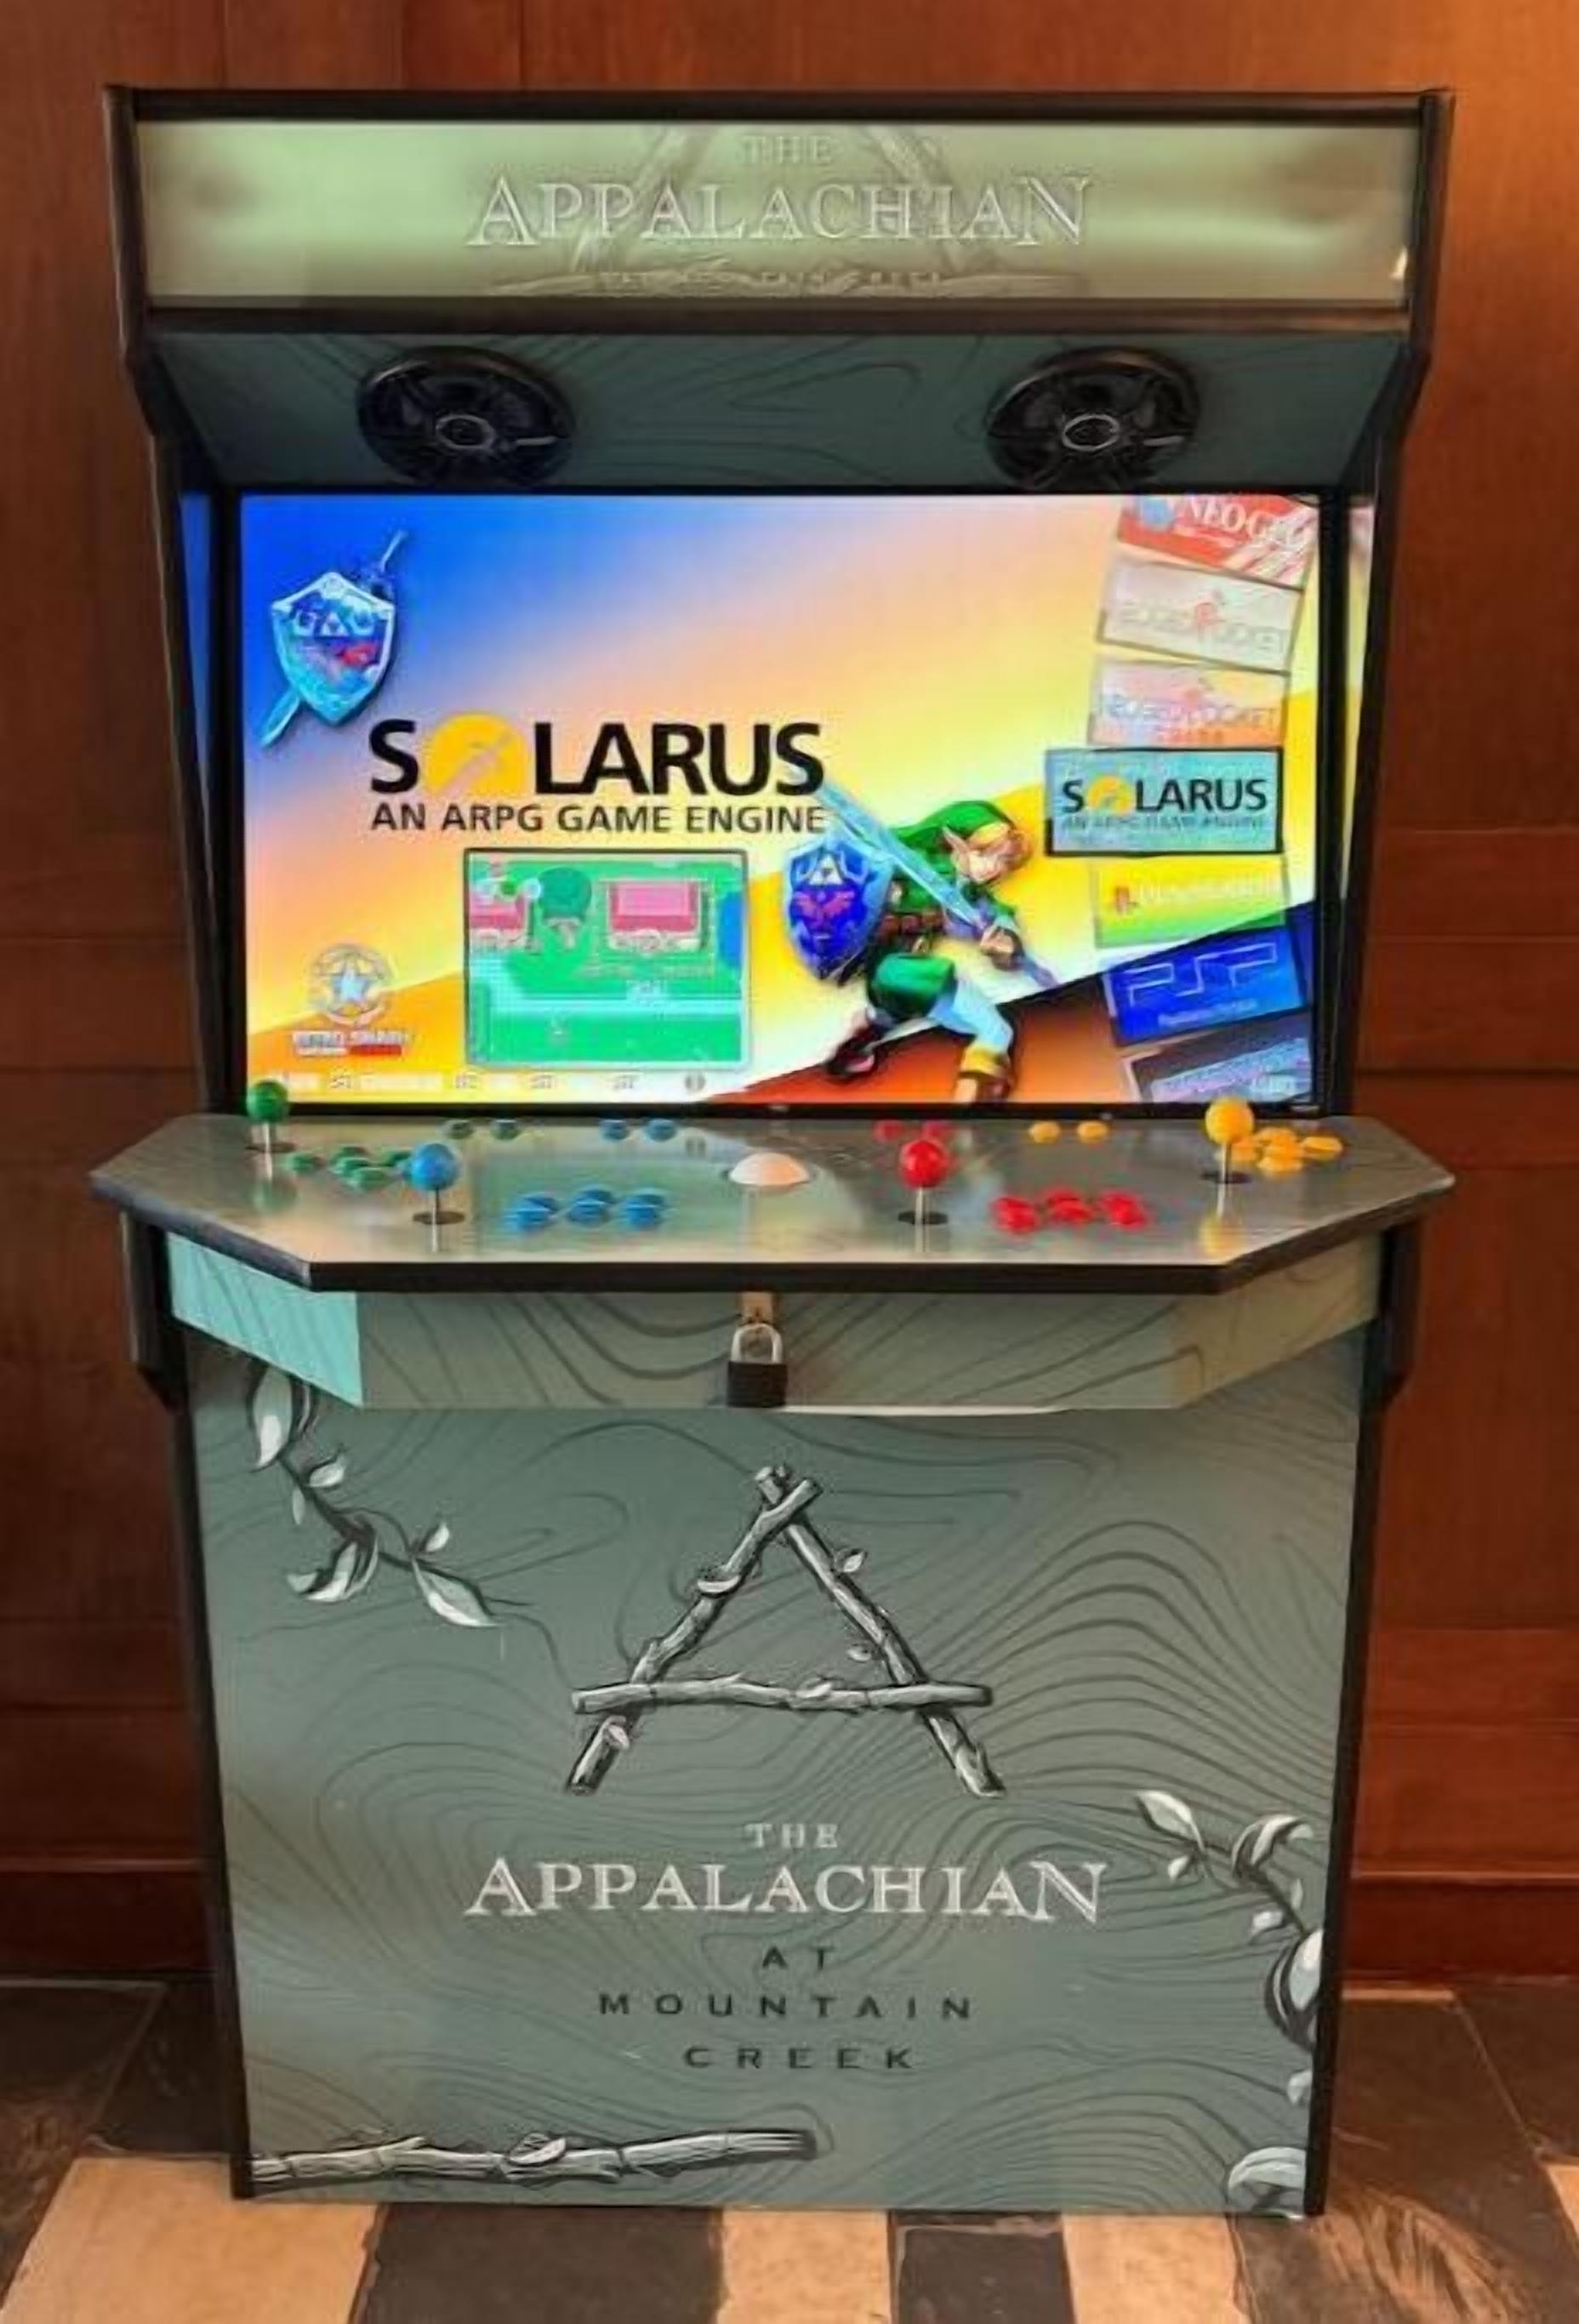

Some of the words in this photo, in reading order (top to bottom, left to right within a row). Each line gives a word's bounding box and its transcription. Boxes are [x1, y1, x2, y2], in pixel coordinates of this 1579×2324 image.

[465, 173, 1092, 247] APPALACHIAN
[370, 803, 426, 830] AN
[441, 803, 543, 832] ARPG
[556, 804, 670, 833] GAME
[685, 805, 826, 834] ENGINE
[1122, 942, 1277, 1007] PSP
[745, 1823, 838, 1849] THE
[464, 1856, 1106, 1925] APPALACHIAN
[761, 1945, 834, 1970] AT
[598, 1993, 972, 2019] MOUNTAIN
[684, 2047, 914, 2071] CREEK
